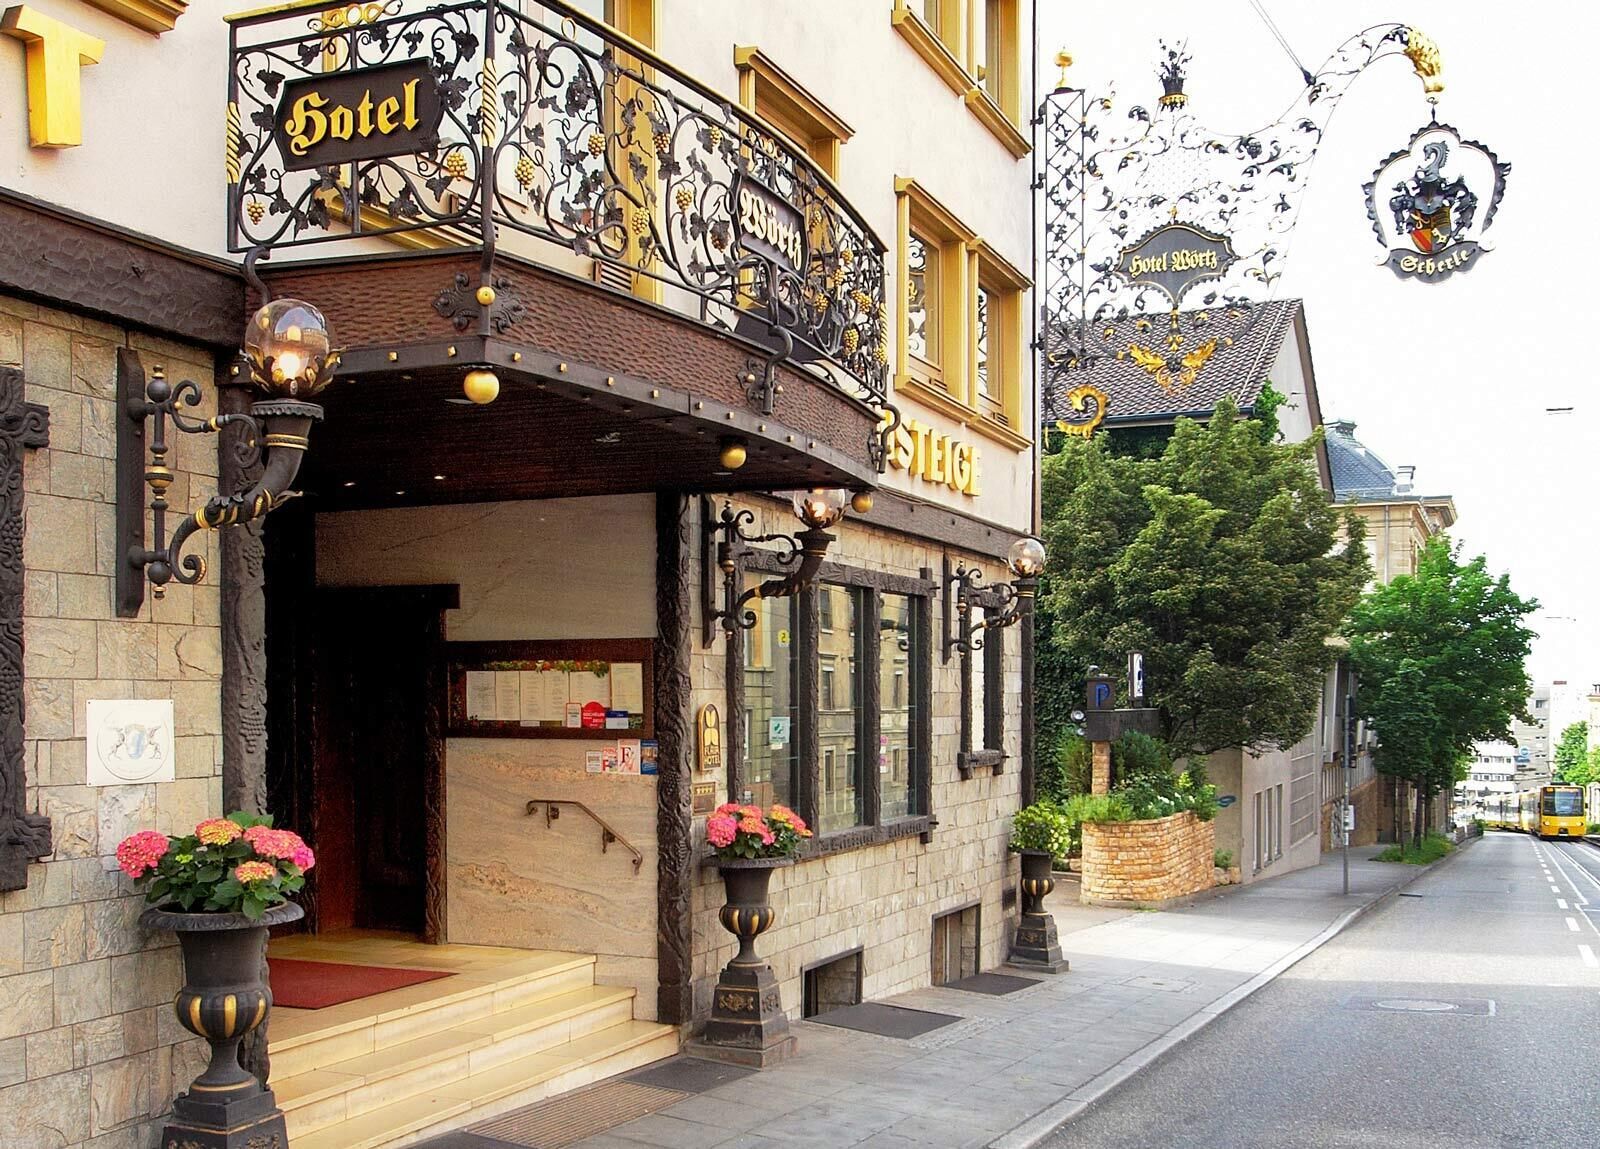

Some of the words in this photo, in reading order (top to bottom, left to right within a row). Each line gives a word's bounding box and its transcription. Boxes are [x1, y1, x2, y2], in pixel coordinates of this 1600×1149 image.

[1, 4, 106, 149] T
[285, 78, 420, 156] Hotel
[740, 187, 802, 271] Wörtz
[1129, 251, 1168, 278] Hotel
[1171, 248, 1218, 272] Wörtz
[1401, 249, 1469, 275] Scherle
[881, 407, 980, 497] STEIGE
[1095, 683, 1110, 707] P
